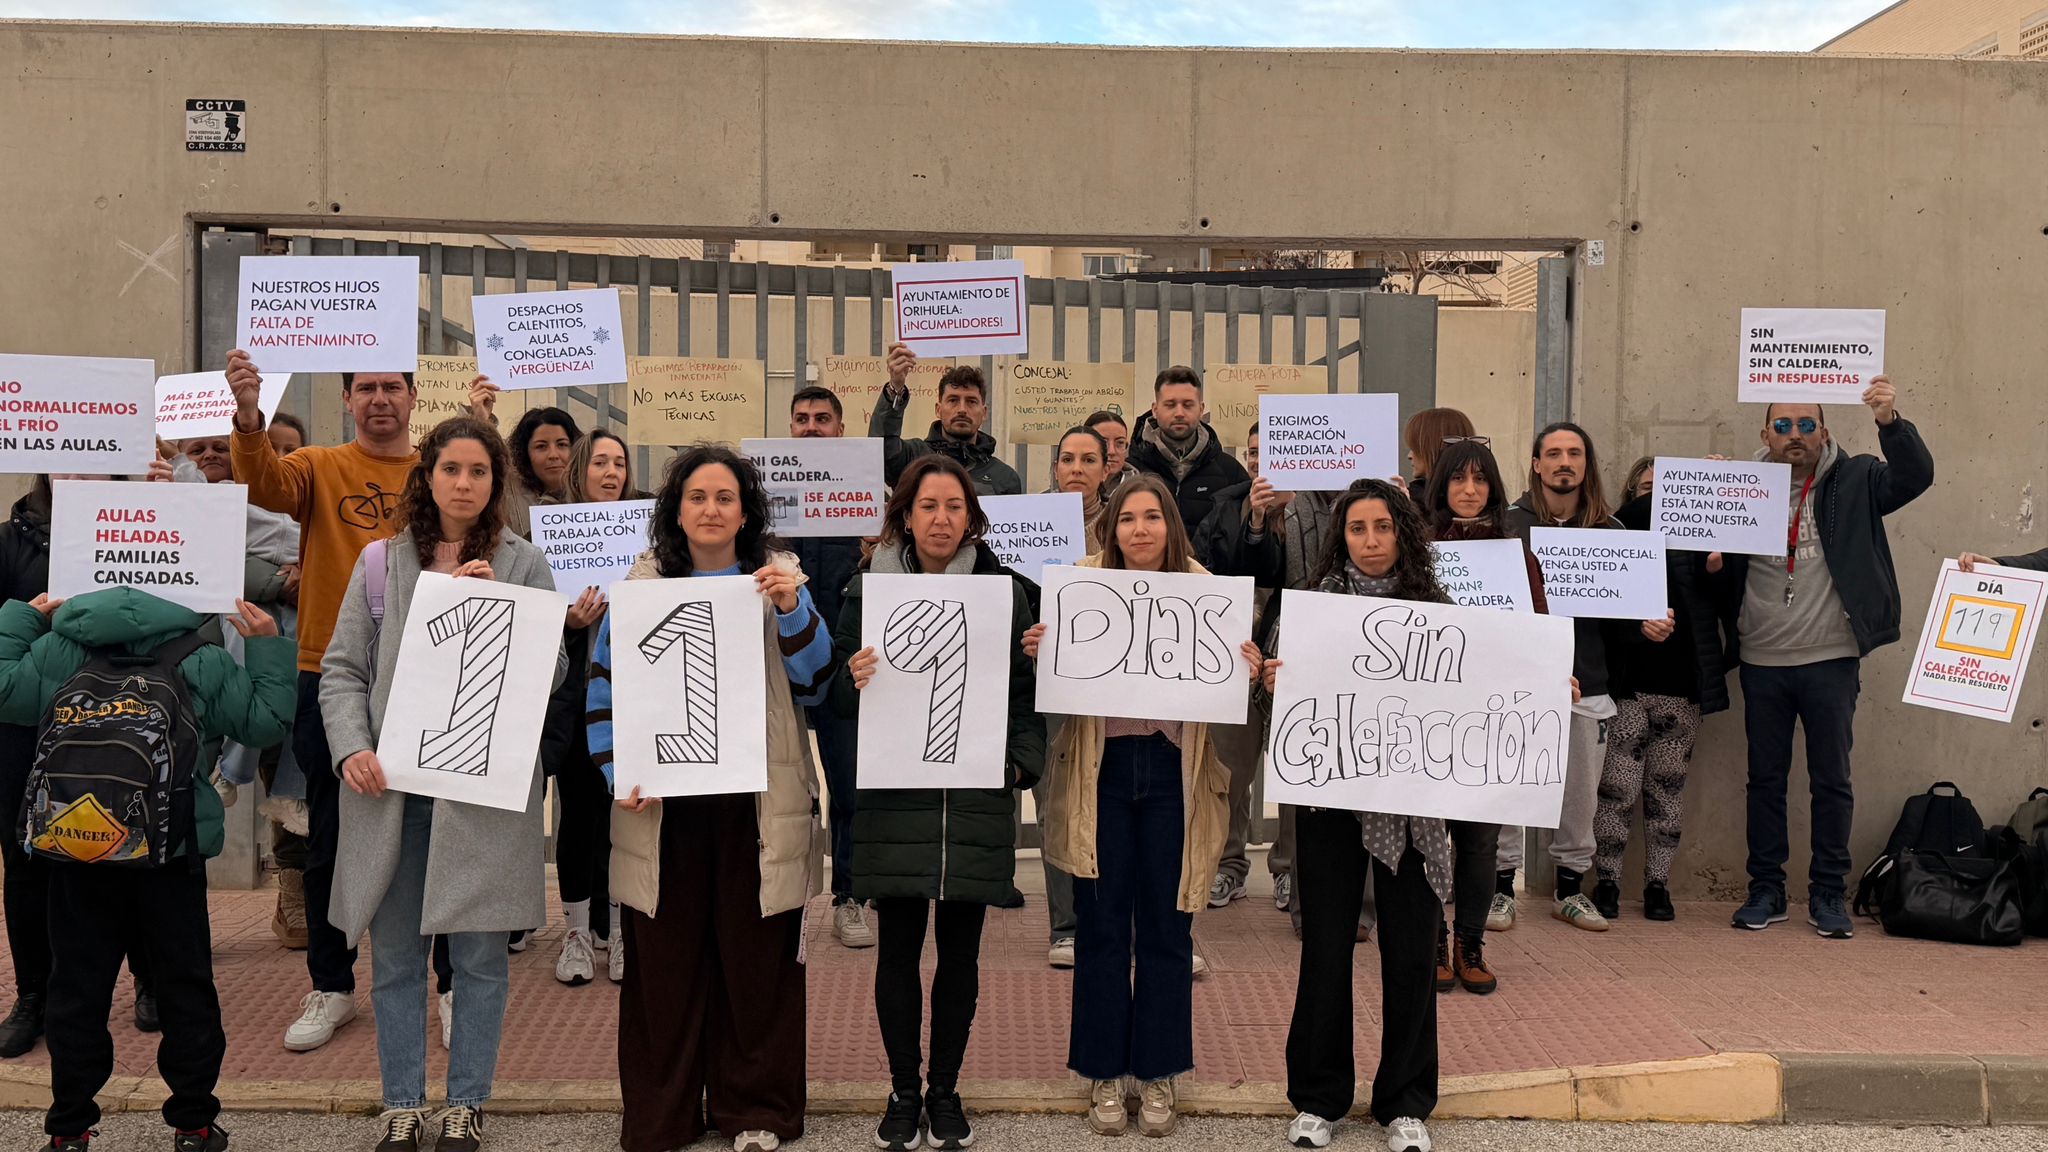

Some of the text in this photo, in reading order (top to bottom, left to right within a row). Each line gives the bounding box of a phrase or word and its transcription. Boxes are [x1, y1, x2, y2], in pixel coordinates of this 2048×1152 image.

[195, 101, 234, 111] CCTV
[188, 142, 229, 150] C.R.A.C.
[251, 281, 380, 294] NUESTROS HIJOS
[902, 287, 1010, 302] AYUNTAMIENTO DE
[251, 298, 377, 311] PAGAN VUESTRA
[508, 303, 584, 318] DESPACHOS
[903, 305, 962, 317] ORIHUELA:
[250, 316, 314, 329] FALTA DE
[507, 317, 586, 332] CALENTITOS,
[904, 317, 1003, 334] ¡INCUMPLIDORES!
[249, 333, 379, 347] MANTENIMINTO.
[528, 333, 569, 345] AULAS
[1750, 328, 1774, 338] SIN
[504, 345, 596, 361] CONGELADAS.
[1750, 343, 1873, 356] MANTENIMIENTO,
[417, 360, 477, 373] PROMESAS
[509, 360, 594, 378] ¡VERGÜENZA!
[1749, 358, 1843, 370] SIN CALDERA,
[1013, 364, 1072, 380] CONCEJAL:
[1268, 365, 1302, 381] ROTA
[1749, 373, 1860, 384] SIN RESPUESTAS
[417, 380, 449, 390] NTAN
[164, 390, 193, 402] MÁS
[197, 390, 215, 399] DE
[220, 389, 225, 397] 1
[633, 387, 653, 406] NO
[664, 388, 694, 402] MÁS
[159, 399, 238, 412] DE INSTANC
[155, 408, 238, 423] SIN RESPUES
[1269, 415, 1329, 426] EXIGIMOS
[0, 416, 59, 432] L FRÍO
[1269, 427, 1346, 441] REPARACIÓN
[0, 438, 122, 452] N LAS AULAS.
[1269, 444, 1365, 457] INMEDIATA. ¡NO
[750, 455, 802, 468] NI GAS,
[1269, 457, 1356, 470] MÁS EXCUSAS!
[771, 471, 843, 482] CALDERA...
[1663, 470, 1761, 485] AYUNTAMIENTO:
[804, 491, 873, 503] ¡SE ACABA
[1662, 484, 1769, 499] VUESTRA GESTIÓN
[1661, 496, 1747, 512] ESTÁ TAN ROTA
[96, 509, 157, 523] AULAS
[541, 508, 654, 526] CONCEJAL: ¿USTE
[804, 506, 878, 518] LA ESPERA!
[1660, 511, 1758, 527] COMO NUESTRA
[542, 524, 636, 540] TRABAJA CON
[988, 521, 1054, 534] ICOS EN LA
[1660, 525, 1717, 539] CALDERA.
[95, 529, 185, 546] HELADAS,
[1008, 535, 1050, 548] NIÑOS
[1052, 536, 1068, 547] EN
[544, 541, 604, 556] ABRIGO?
[1537, 546, 1657, 559] ALCALDE/CONCEJAL:
[94, 550, 180, 564] FAMILIAS
[617, 555, 636, 566] HIJ
[1582, 561, 1617, 572] USTED
[1619, 562, 1629, 572] A
[94, 570, 199, 586] CANSADAS.
[1543, 573, 1595, 584] LASE SIN
[1546, 586, 1623, 599] ALEFACCIÓN.
[1977, 579, 2004, 595] DÍA
[1458, 594, 1514, 607] CALDERA
[1955, 607, 2003, 639] 119
[1352, 604, 1466, 683] Sin
[1958, 656, 1982, 669] SIN
[1924, 661, 2011, 685] CALEFACCIÓN
[418, 597, 515, 776] 1
[638, 600, 718, 765] 1
[883, 599, 968, 764] 9
[1922, 671, 1950, 681] NADA
[1968, 679, 2008, 692] RESUELTO
[1273, 691, 1562, 788] Calefacción
